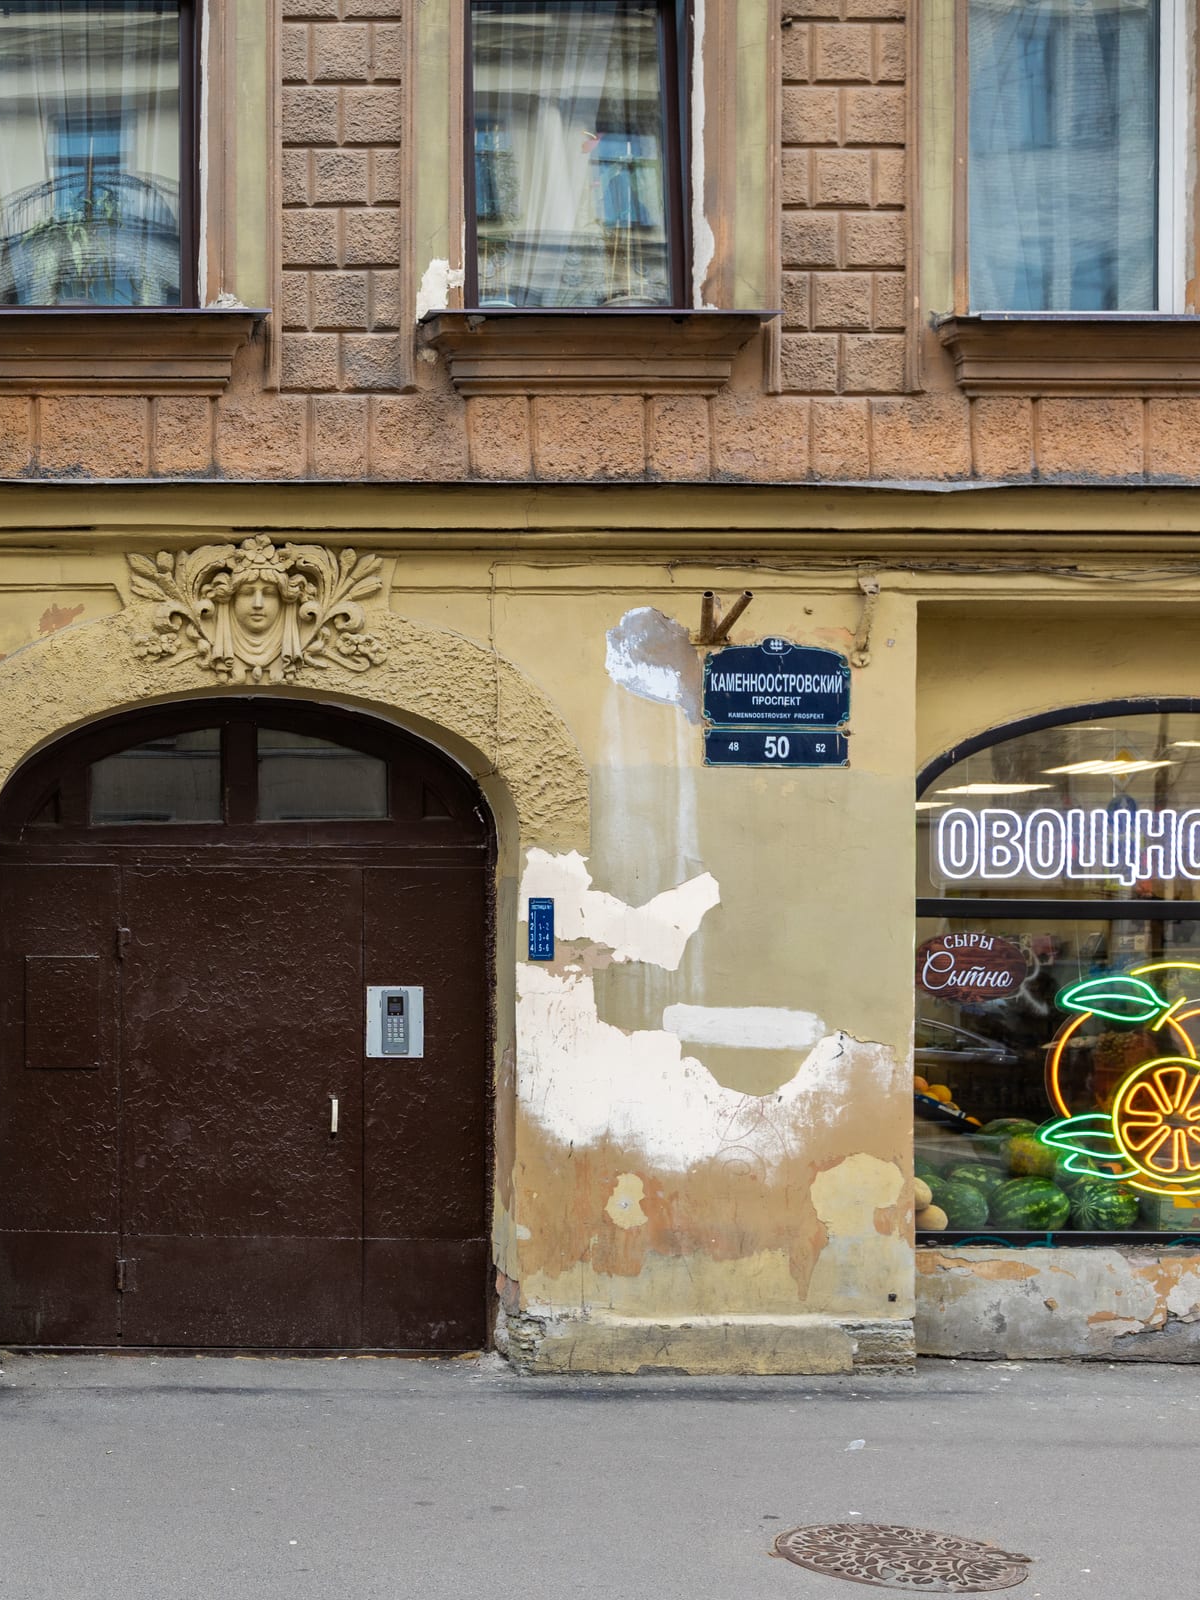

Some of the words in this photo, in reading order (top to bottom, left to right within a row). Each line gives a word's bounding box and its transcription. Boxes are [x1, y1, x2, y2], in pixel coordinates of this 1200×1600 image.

[711, 670, 843, 693] КАМЕННООСТРОВСКИЙ
[752, 696, 802, 706] ПРОСПЕКТ
[793, 712, 824, 720] PROSPEKT
[728, 742, 739, 751] 48
[764, 736, 790, 759] 50
[815, 743, 826, 753] 52
[943, 933, 994, 951] СЫРЫ
[922, 950, 1013, 990] Сытно
